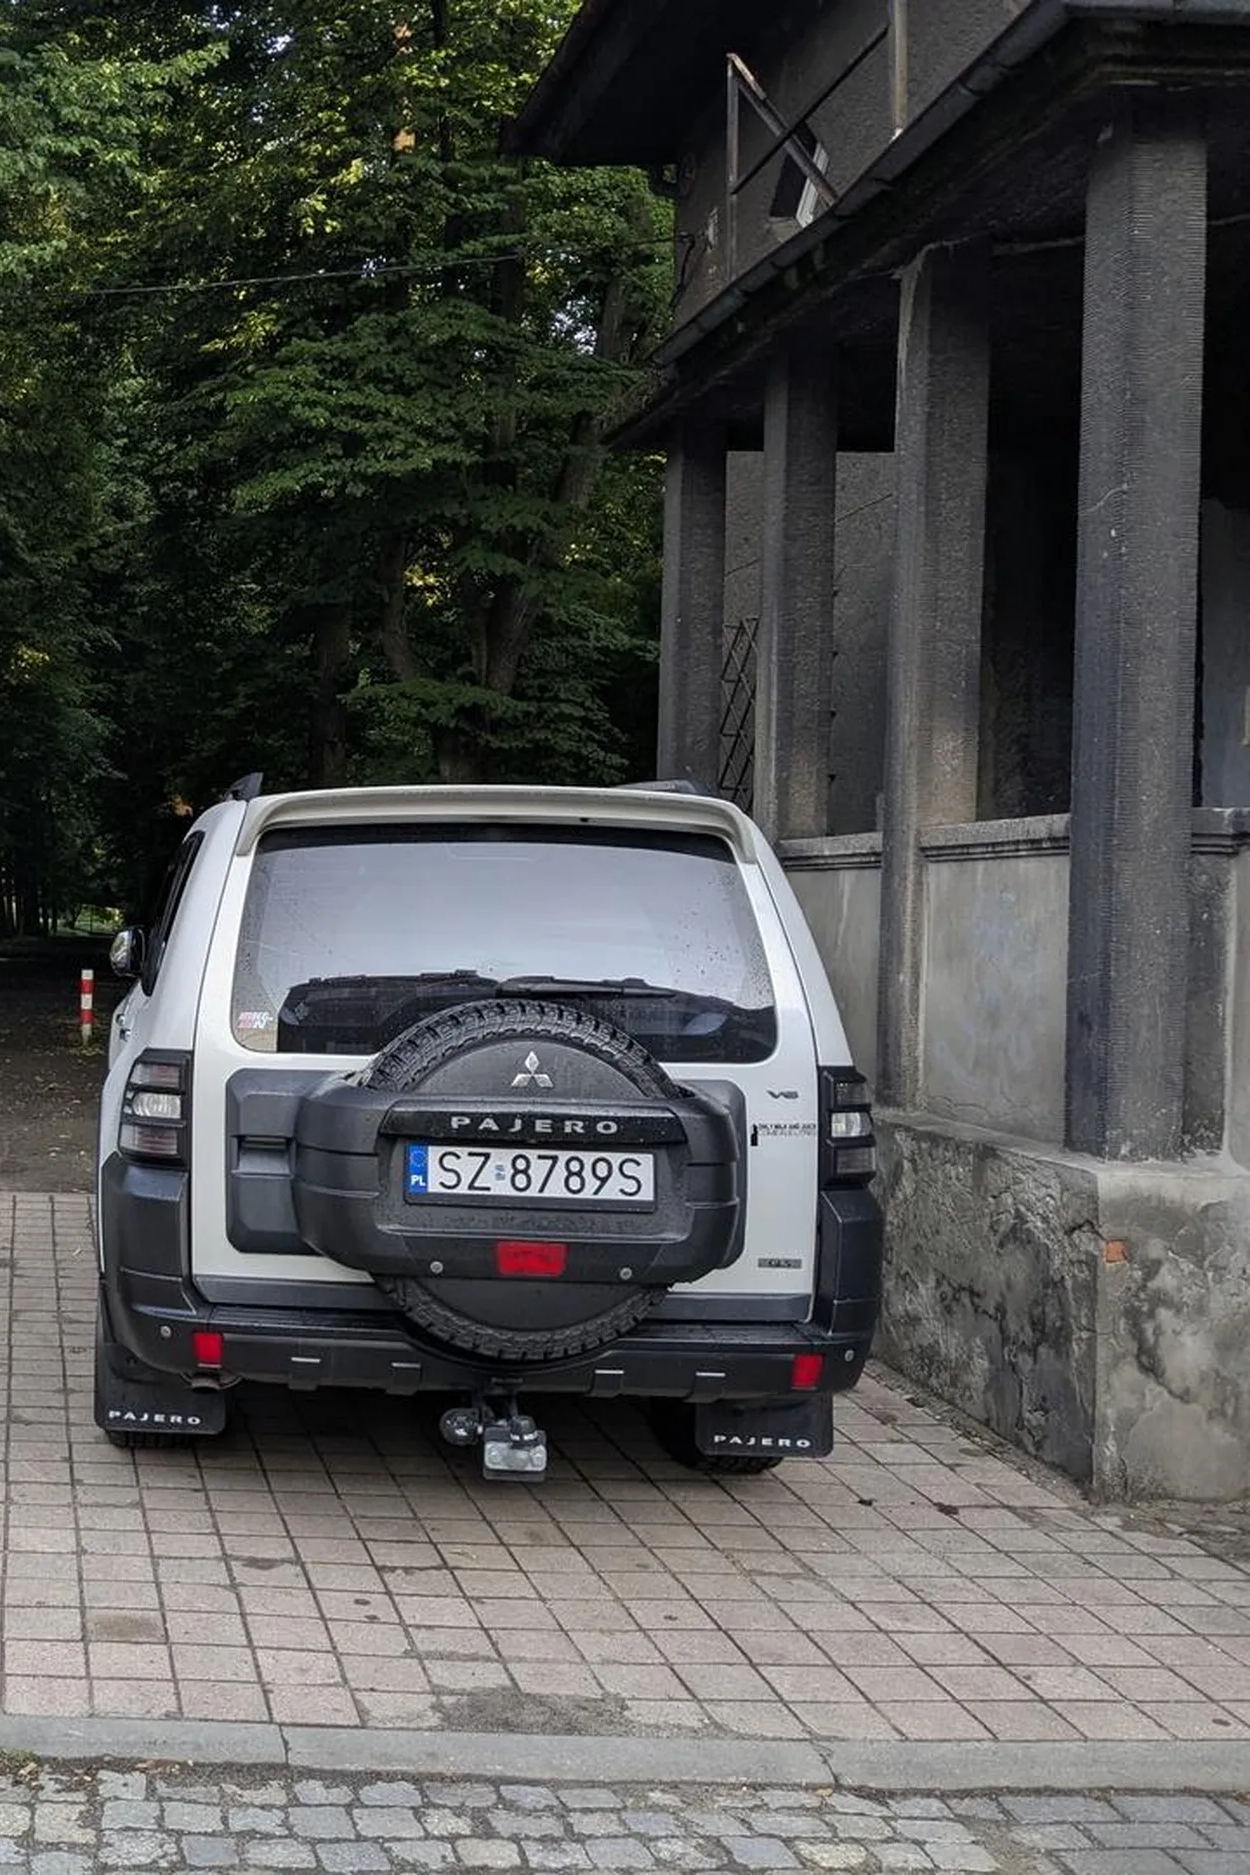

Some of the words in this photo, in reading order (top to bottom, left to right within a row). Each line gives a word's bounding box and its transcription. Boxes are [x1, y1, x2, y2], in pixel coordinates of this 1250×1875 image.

[450, 1116, 619, 1135] PAJERO
[411, 1174, 427, 1187] PL
[438, 1151, 492, 1191] SZ
[510, 1153, 643, 1197] 8789S
[108, 1410, 201, 1425] PAJERO
[713, 1435, 811, 1448] PAJERO
